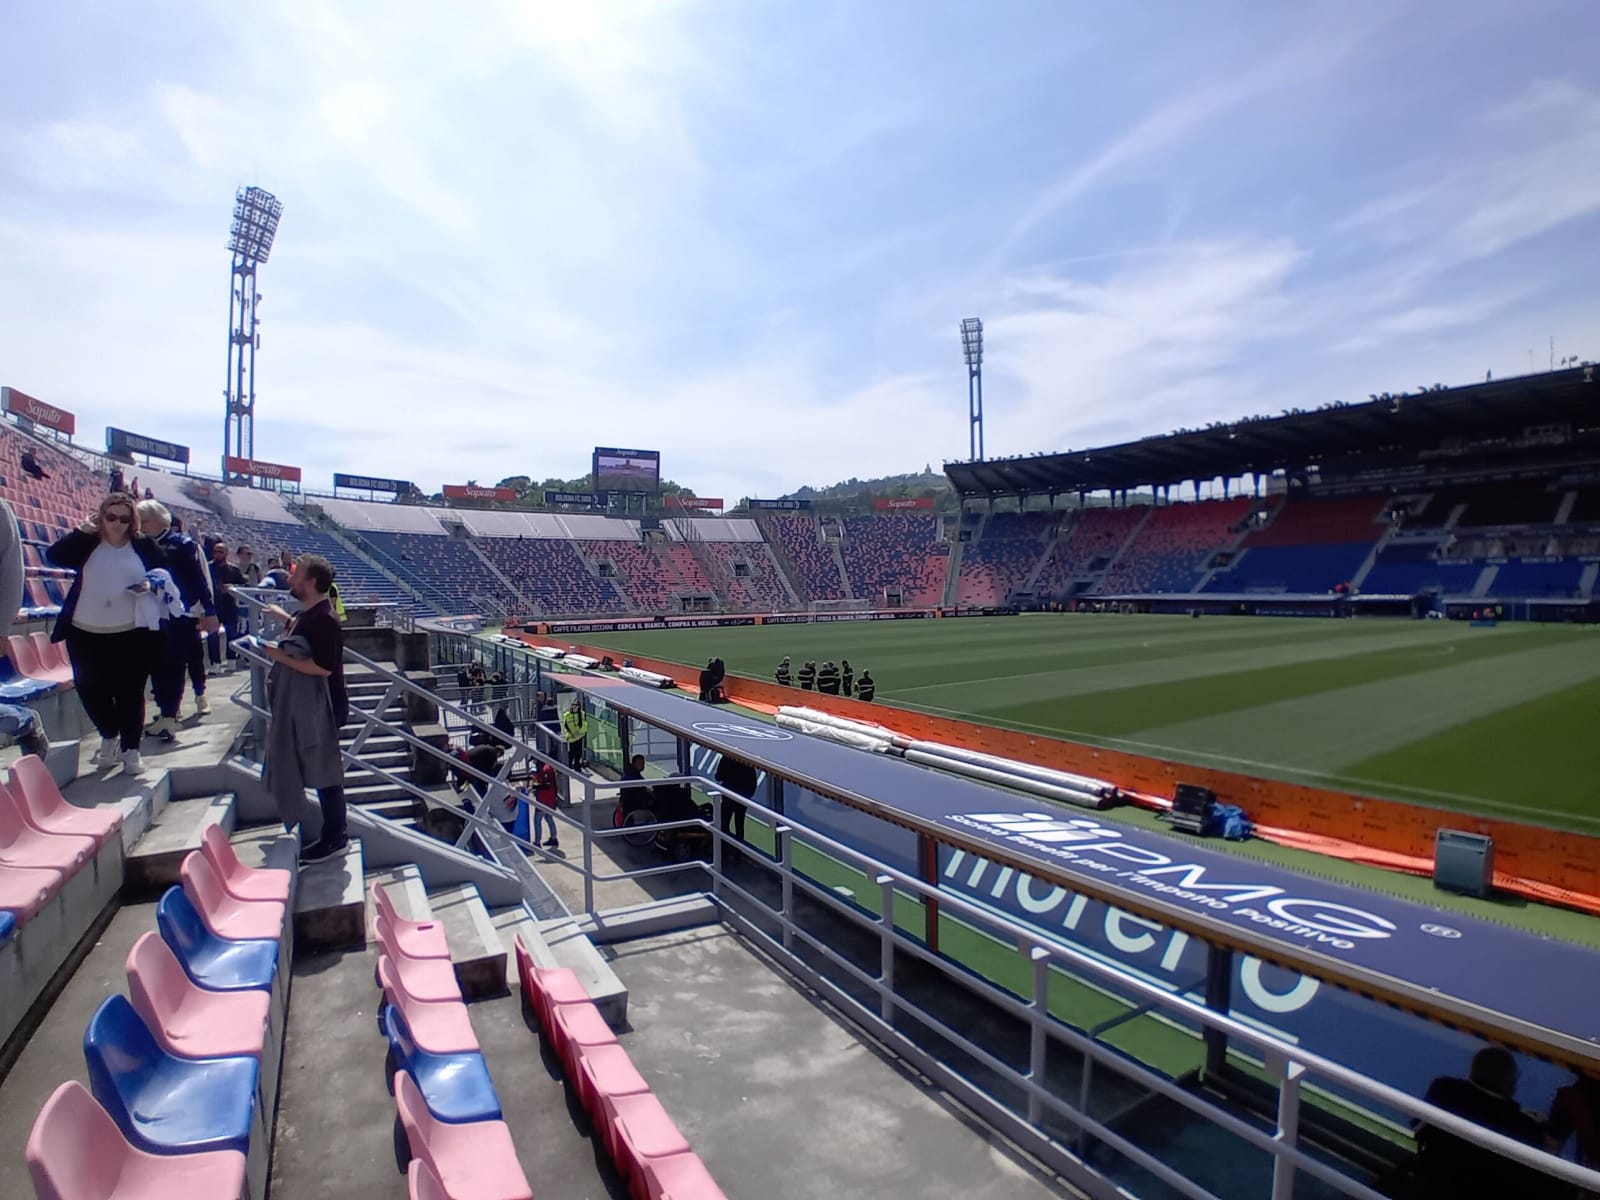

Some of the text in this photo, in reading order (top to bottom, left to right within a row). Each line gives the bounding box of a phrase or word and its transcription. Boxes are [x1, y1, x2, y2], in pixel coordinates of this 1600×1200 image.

[26, 399, 61, 423] Saputo
[247, 461, 282, 475] Saputo
[464, 486, 497, 499] Saputo
[681, 497, 709, 508] Saputo
[1073, 857, 1118, 872] per
[1232, 907, 1355, 949] Positivo
